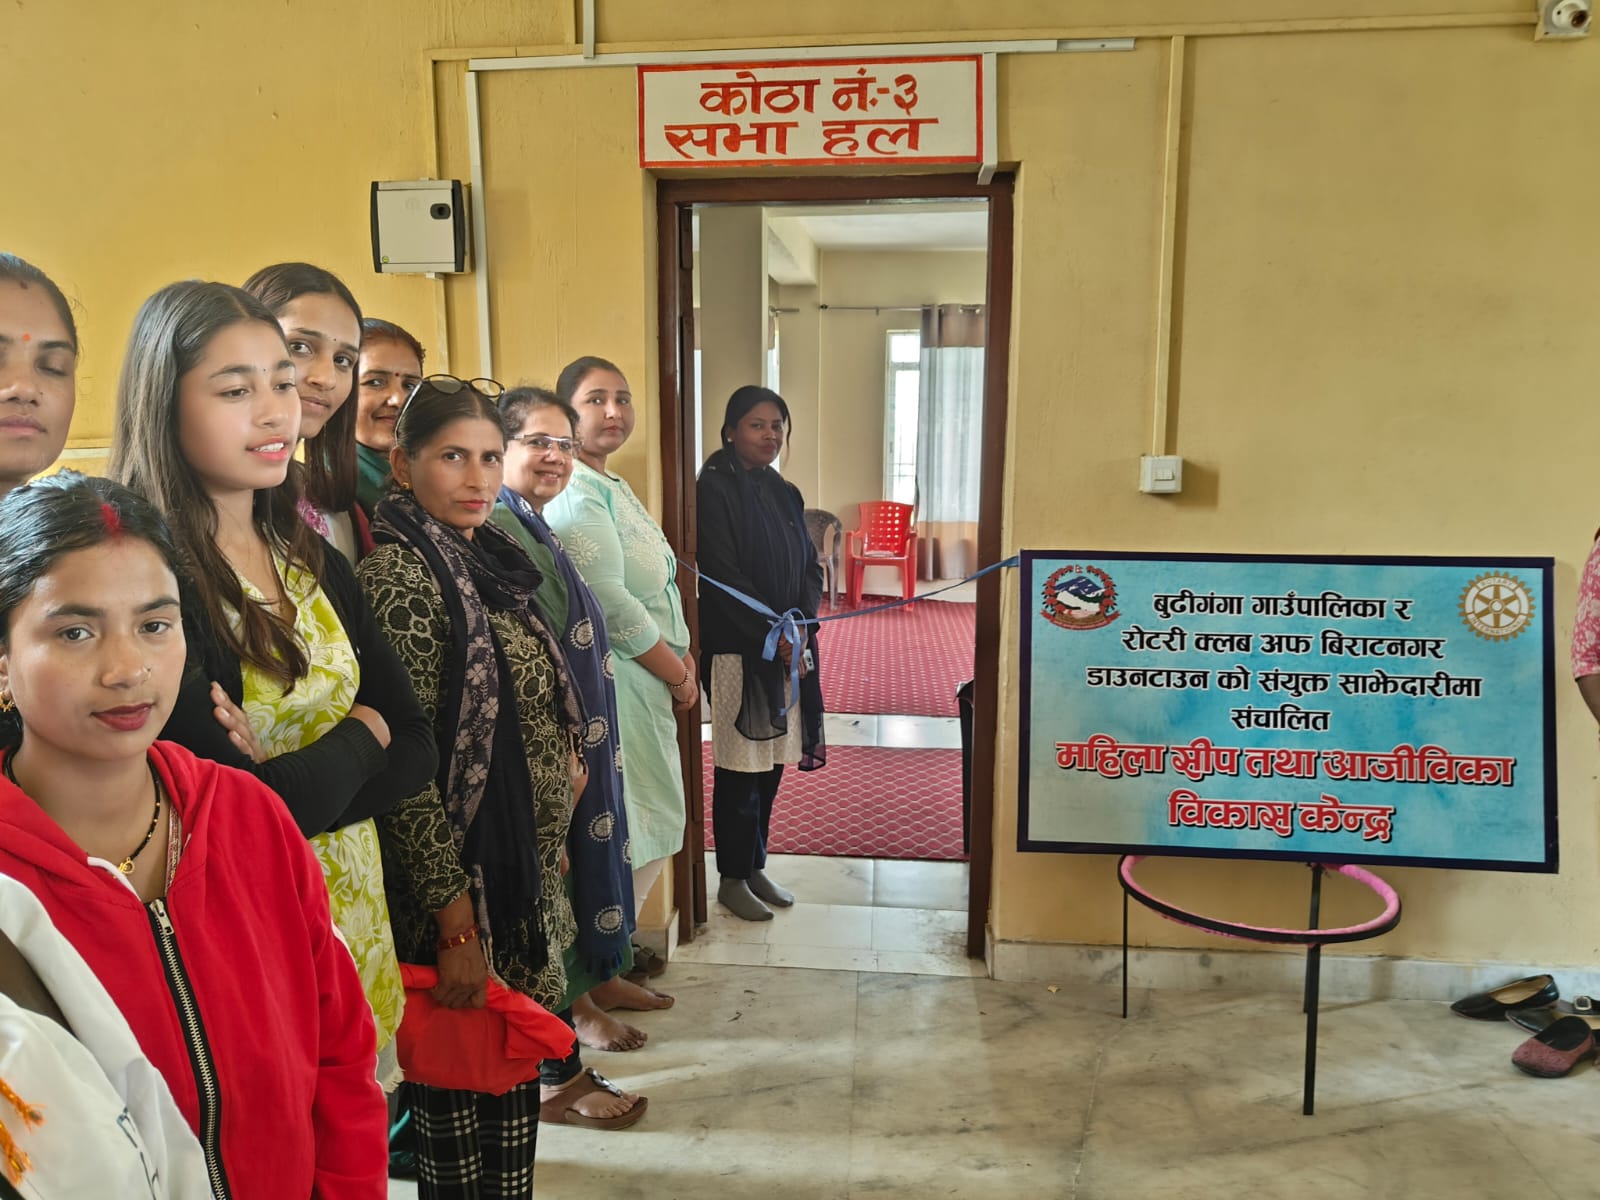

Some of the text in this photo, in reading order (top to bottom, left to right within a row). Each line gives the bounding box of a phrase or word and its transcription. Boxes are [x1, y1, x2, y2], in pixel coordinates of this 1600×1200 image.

[699, 71, 821, 116] कोठा
[664, 117, 939, 159] सभा हल
[1153, 589, 1413, 620] बुढीगंगा गाउँपालिका र
[1122, 625, 1446, 659] रोटरी क्लब अफ बिराटनगर
[1087, 667, 1210, 689] डाउनटाउन
[1217, 665, 1251, 690] को
[1258, 668, 1331, 697] संयुक्त
[1231, 704, 1331, 730] संचालित
[1055, 734, 1515, 784] महिला सीप तथा आजीविका
[1168, 789, 1395, 841] विकास केन्द्र
